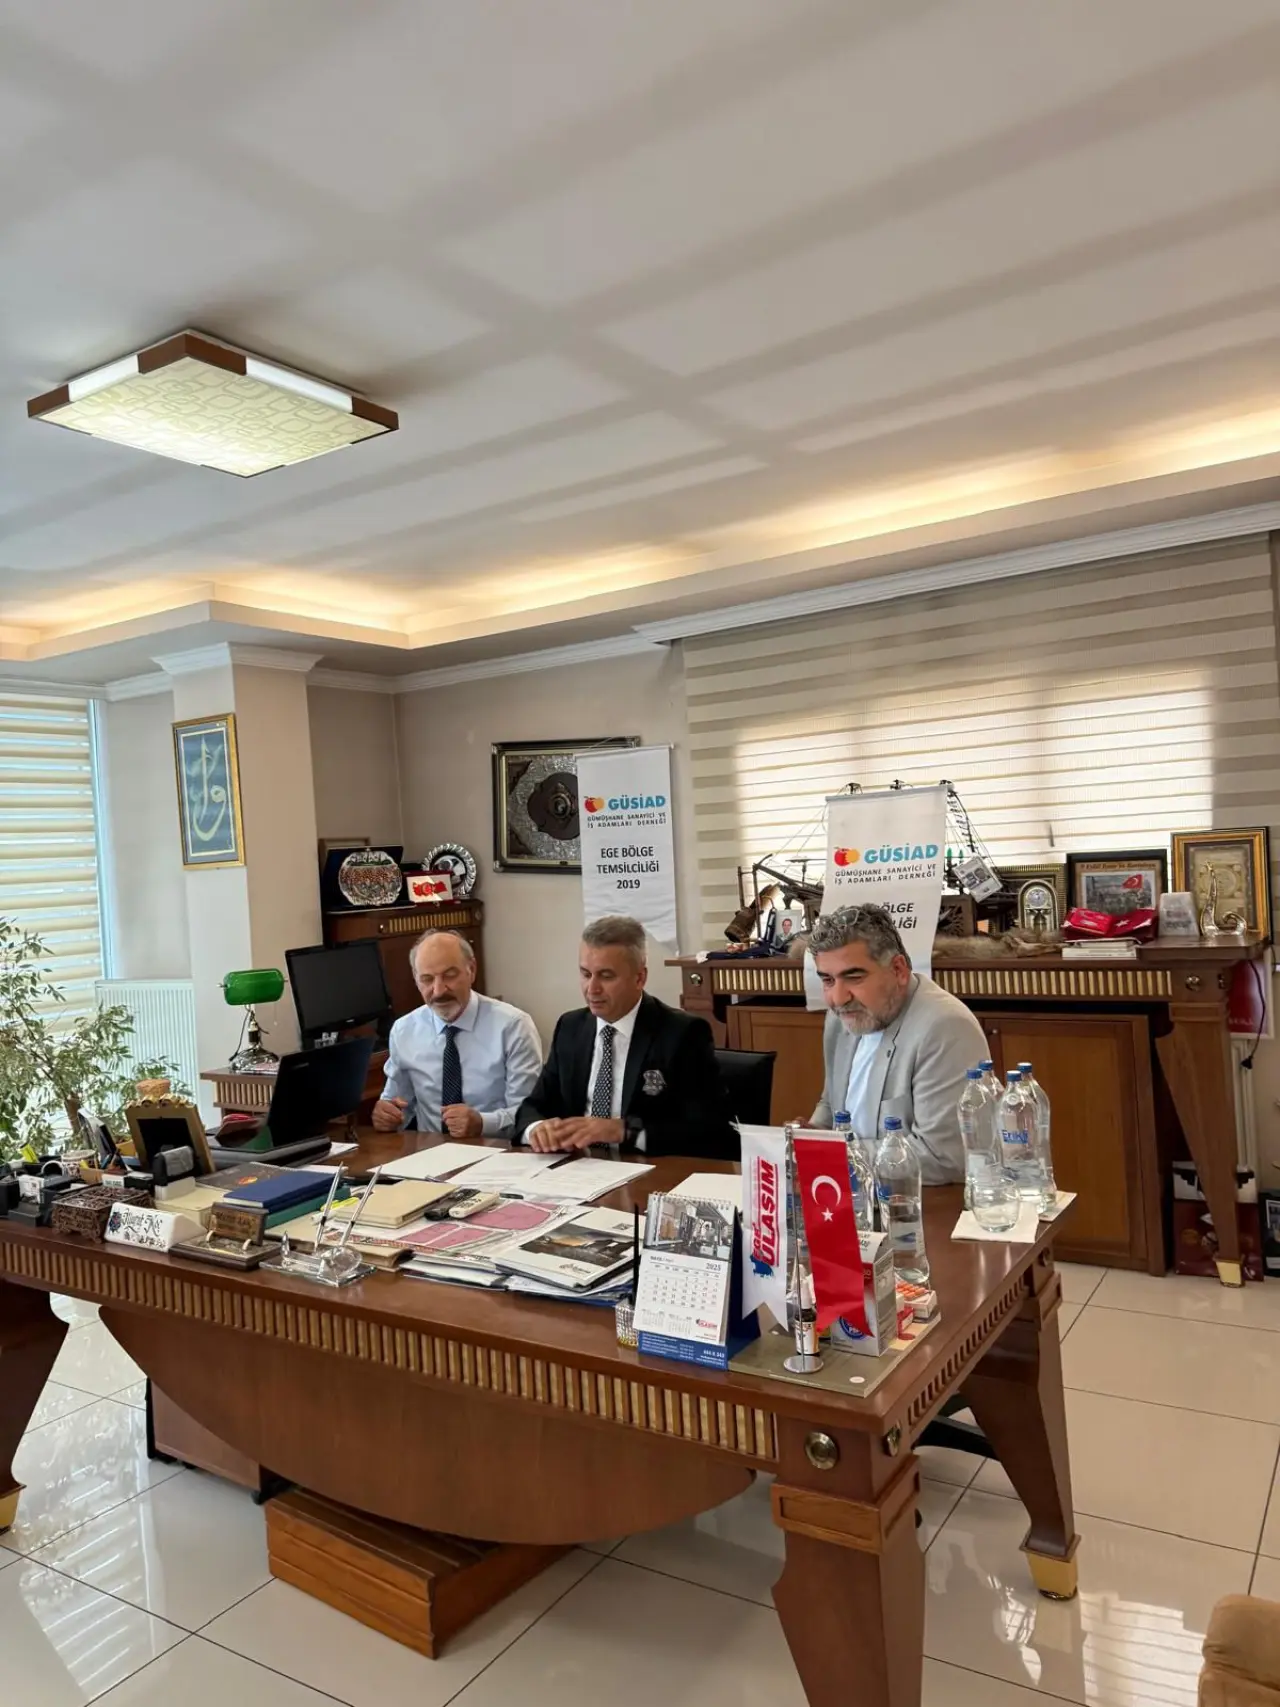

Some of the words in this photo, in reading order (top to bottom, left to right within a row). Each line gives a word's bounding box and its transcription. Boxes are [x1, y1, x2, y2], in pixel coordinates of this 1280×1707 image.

[608, 793, 666, 810] GÜSİAD
[587, 814, 624, 822] GÜMÜŞHANE
[638, 818, 666, 826] DERNEĞİ
[601, 847, 619, 859] EGE
[621, 845, 654, 858] BÖLGE
[864, 843, 939, 863] GÜSİAD
[597, 860, 659, 873] TEMSİLCİLİĞİ
[835, 868, 882, 877] GÜMÜŞHANE
[886, 865, 923, 874] SANAYİCİ
[898, 871, 936, 880] DERNEĞİ
[616, 879, 641, 889] 2019
[877, 902, 914, 913] ÖLGE
